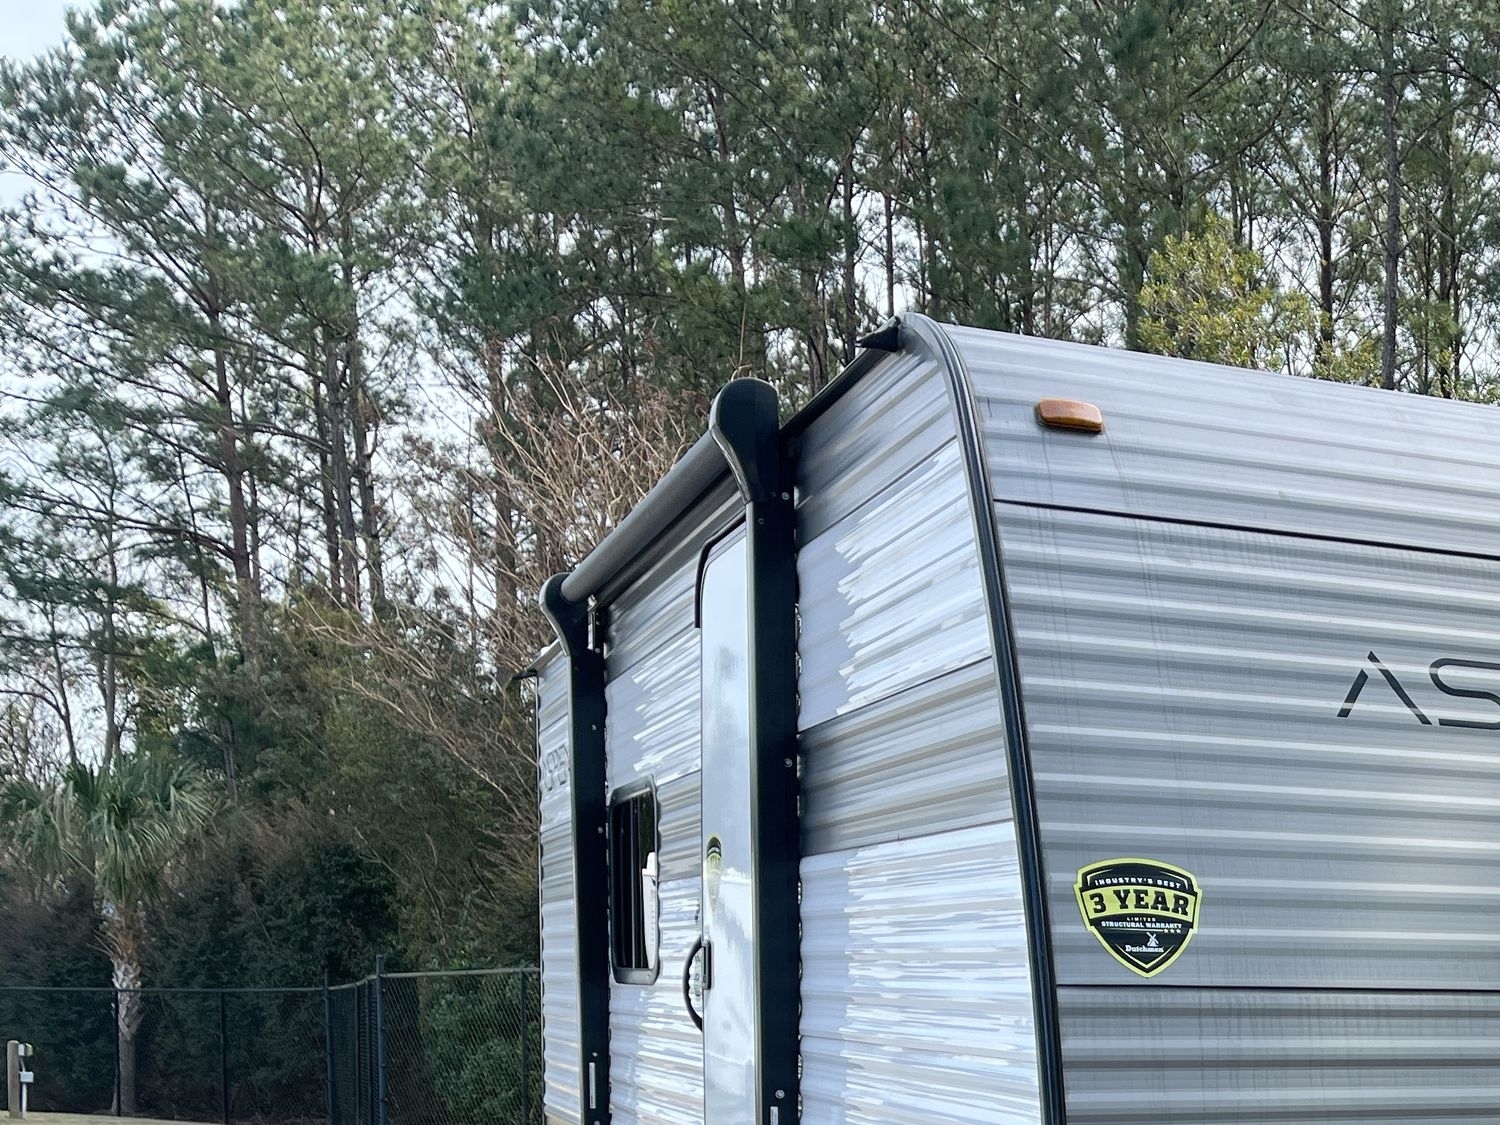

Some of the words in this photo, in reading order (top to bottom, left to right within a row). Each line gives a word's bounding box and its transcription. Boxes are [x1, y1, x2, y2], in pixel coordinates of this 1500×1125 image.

[1157, 879, 1181, 889] BEST
[1089, 892, 1107, 914] 3
[1113, 889, 1189, 916] YEAR
[1125, 944, 1164, 953] Dutchmen
